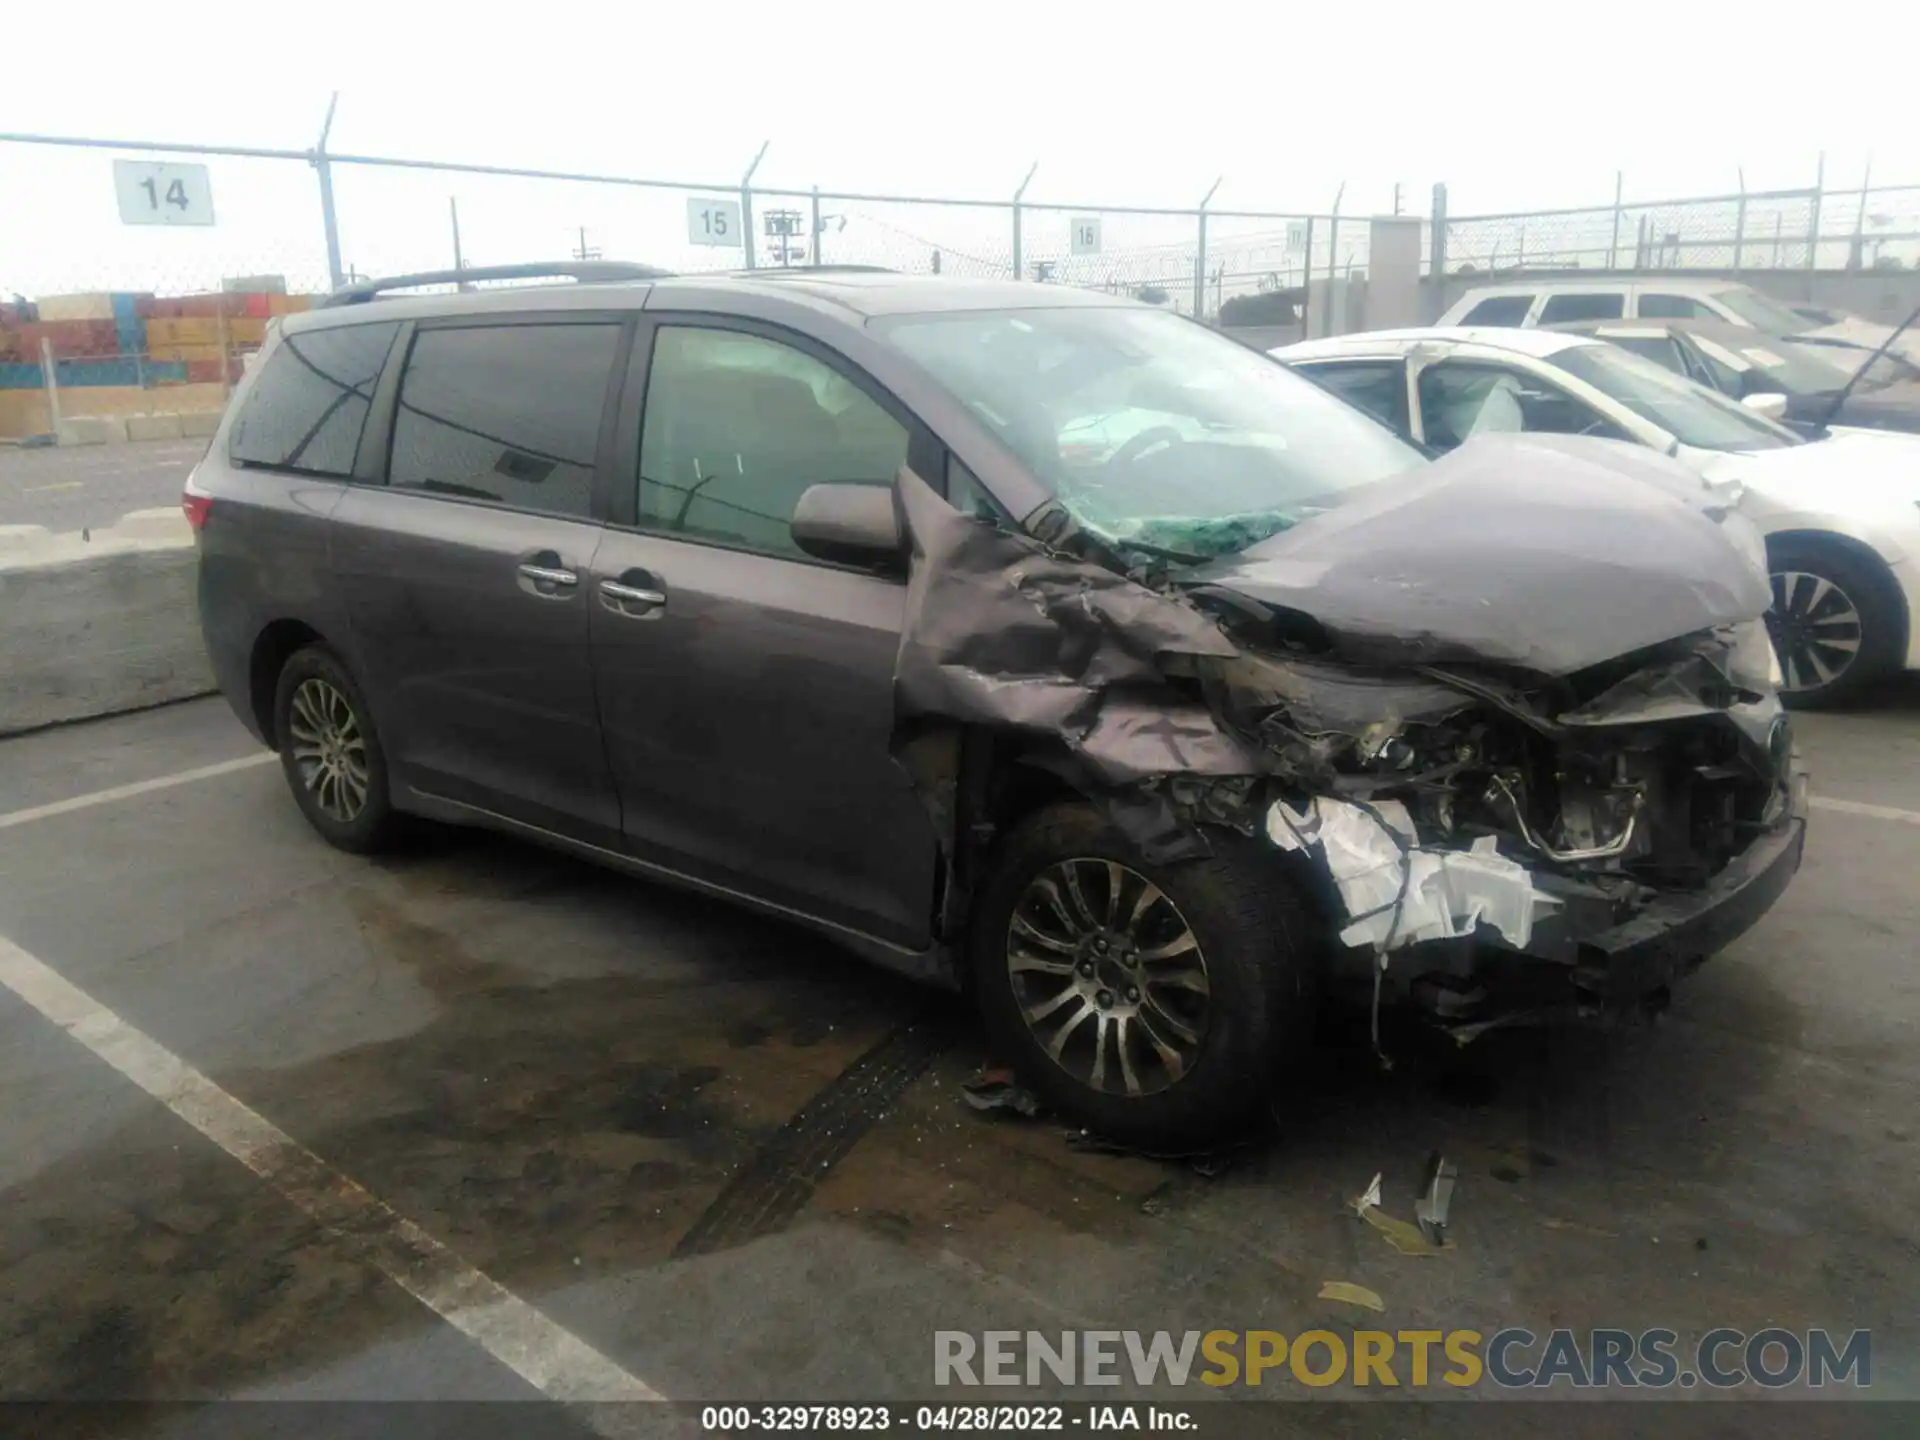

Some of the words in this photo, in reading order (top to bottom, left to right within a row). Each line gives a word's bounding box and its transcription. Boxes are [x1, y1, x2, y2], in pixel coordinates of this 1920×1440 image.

[140, 176, 189, 211] 14
[701, 210, 727, 236] 15
[1079, 225, 1094, 245] 16
